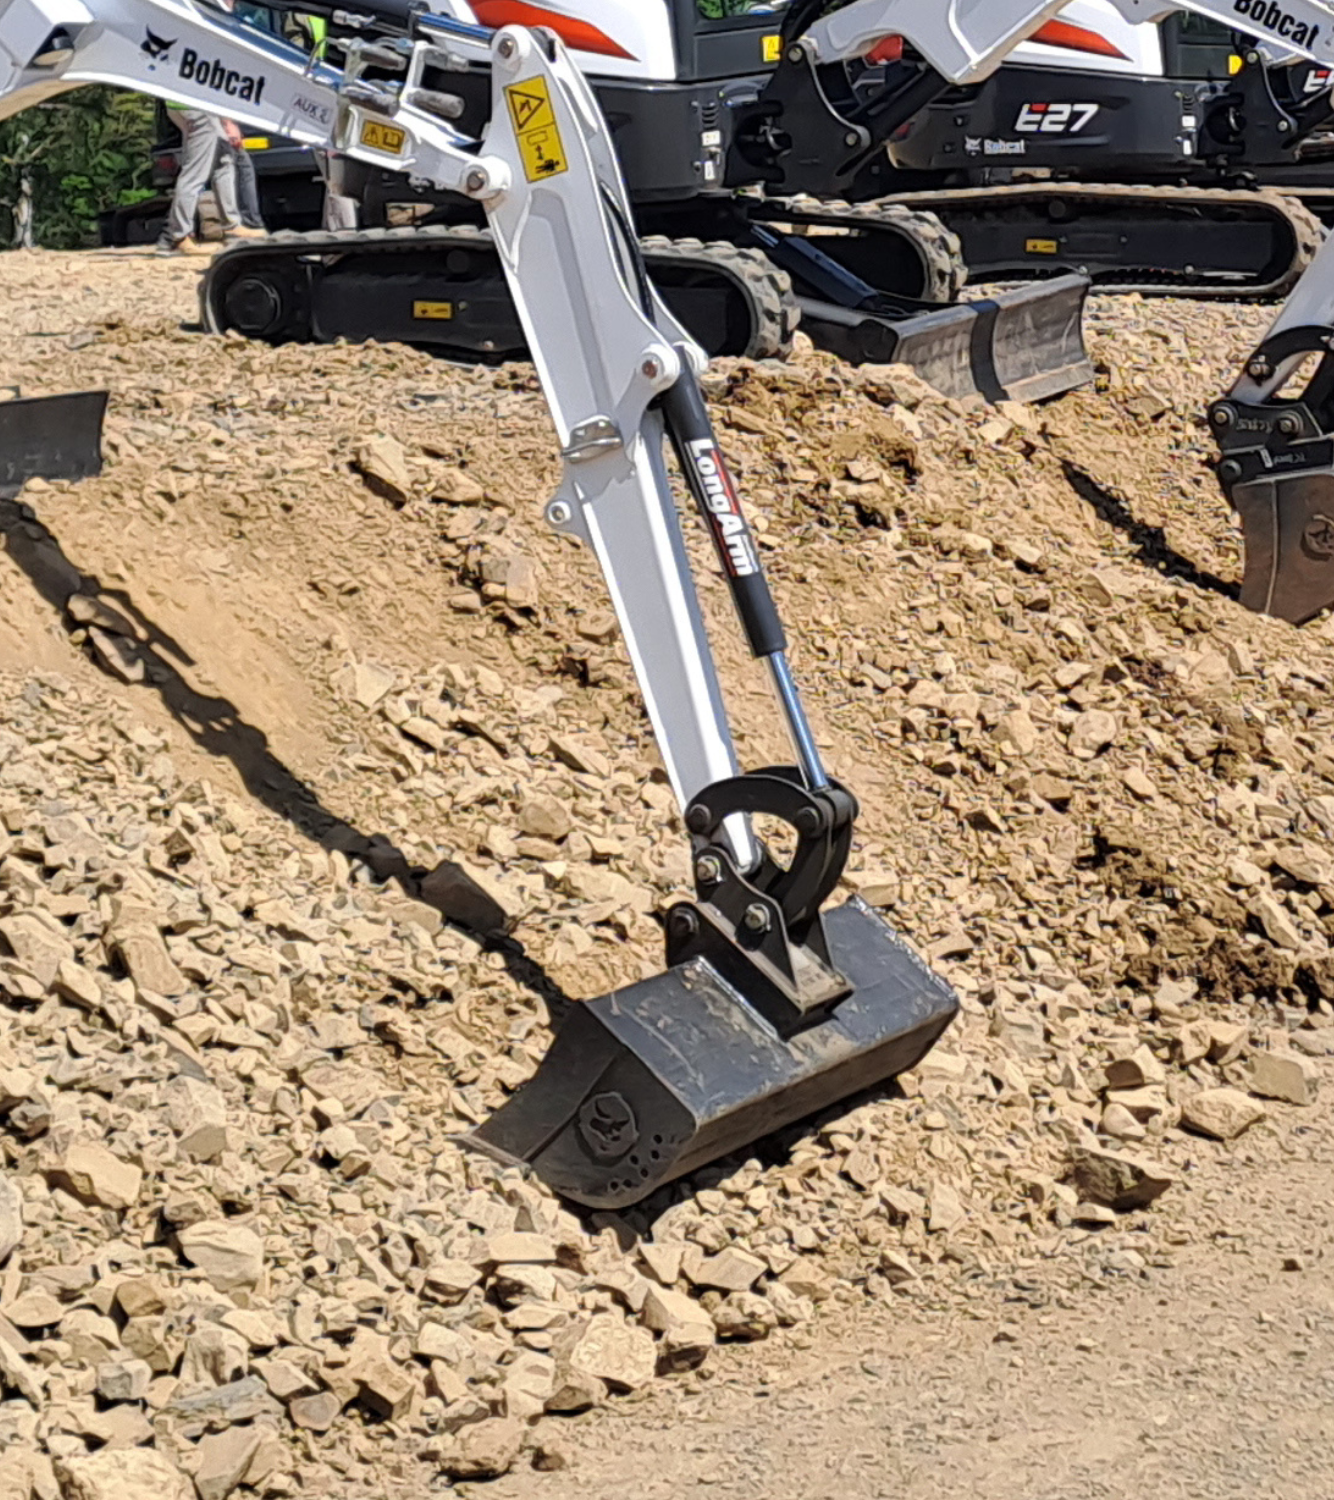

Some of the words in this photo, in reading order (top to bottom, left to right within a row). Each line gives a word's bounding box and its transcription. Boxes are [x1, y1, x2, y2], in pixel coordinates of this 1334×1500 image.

[178, 47, 266, 106] Bobcat
[1014, 102, 1100, 132] E27
[983, 138, 1026, 155] Bobcat
